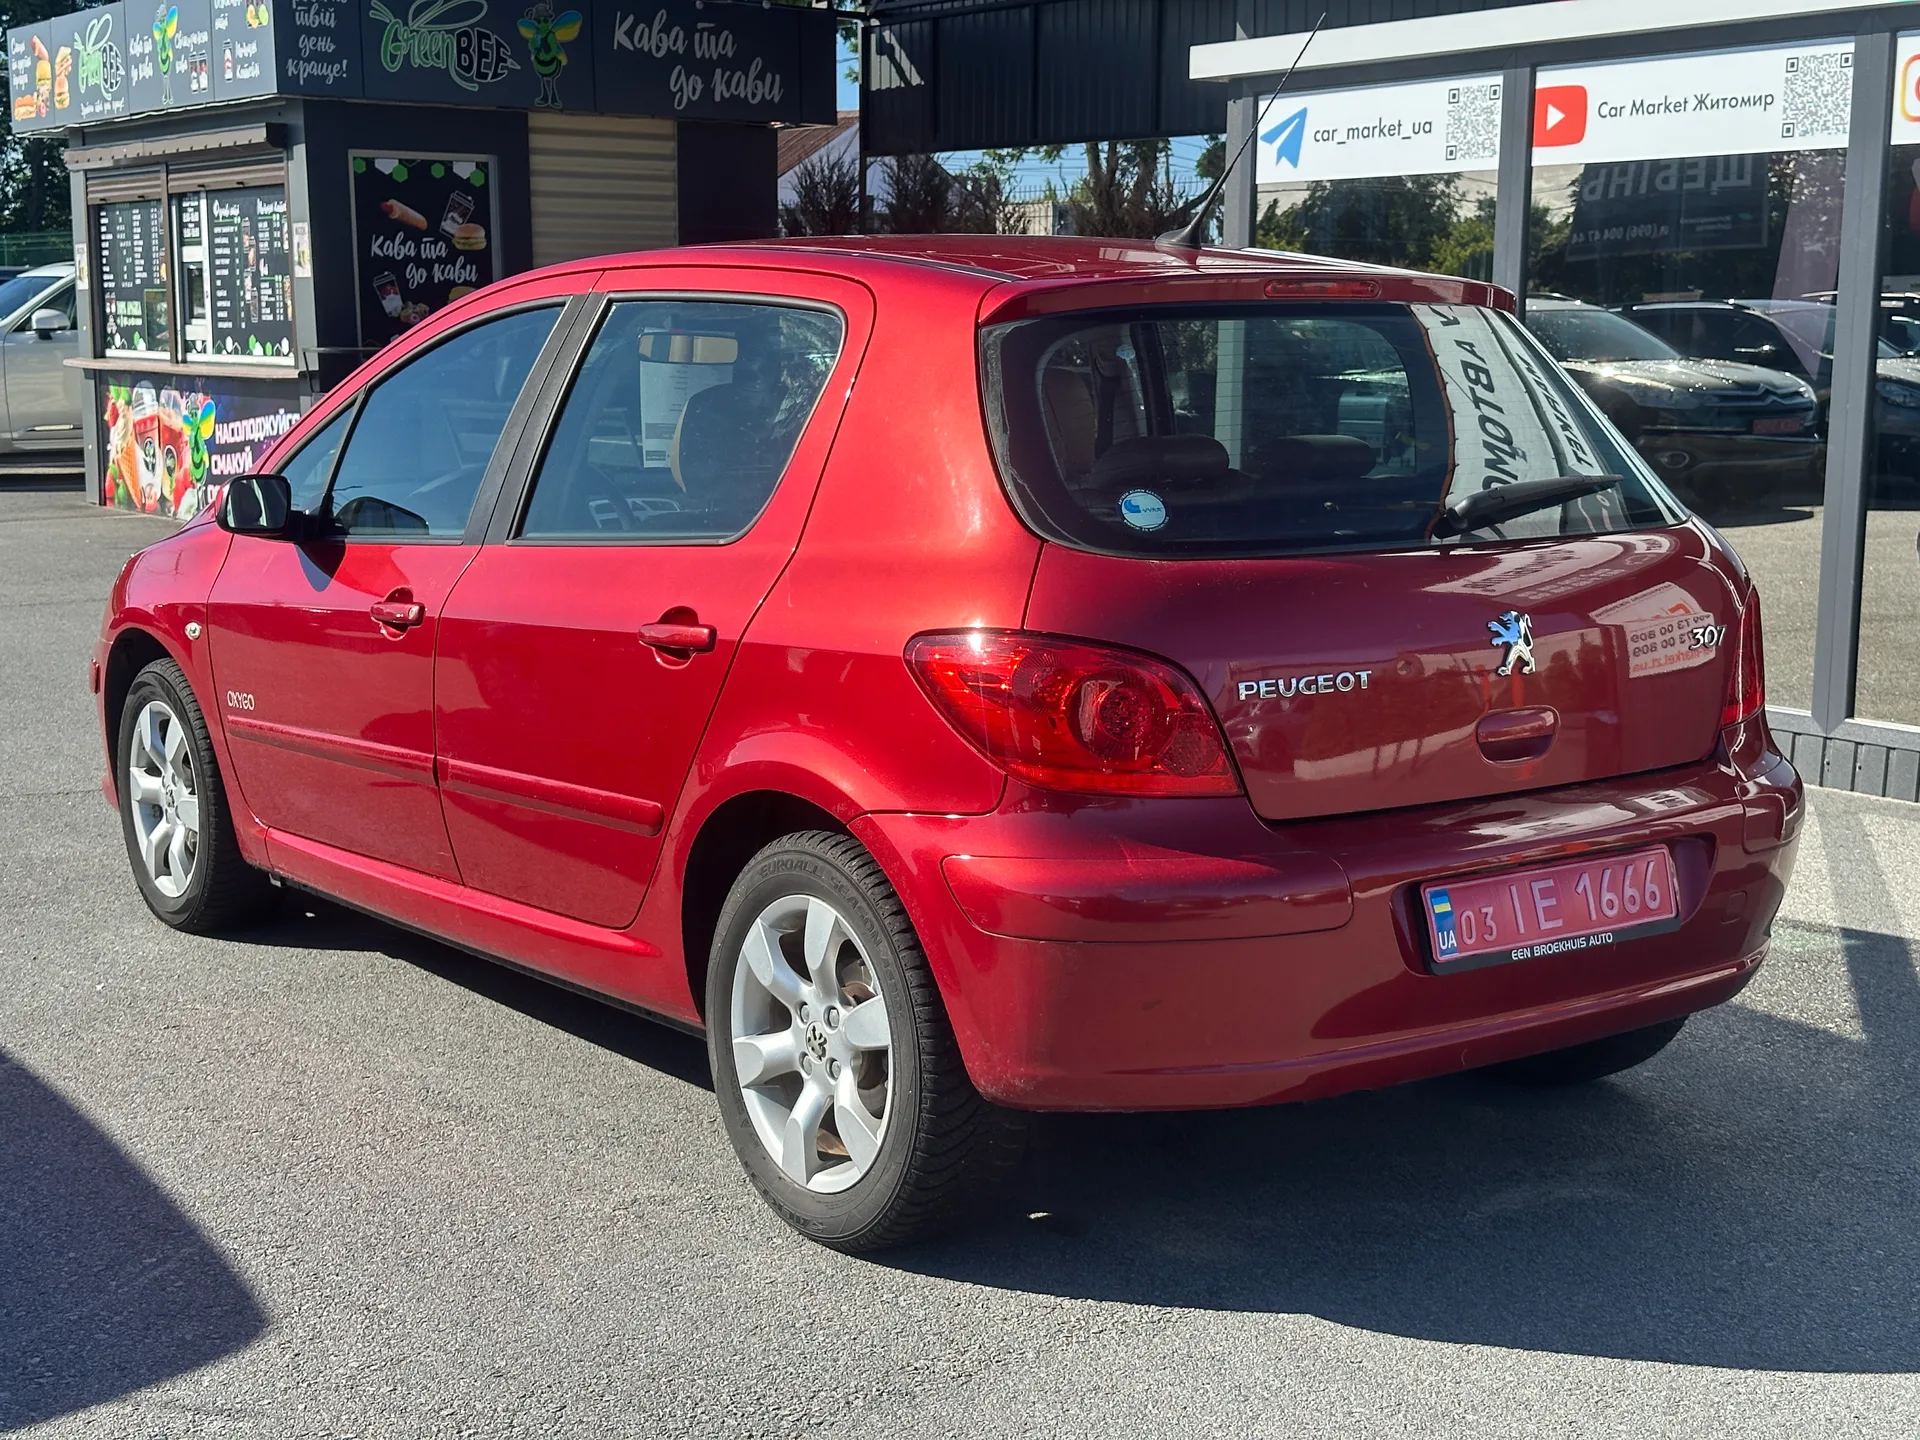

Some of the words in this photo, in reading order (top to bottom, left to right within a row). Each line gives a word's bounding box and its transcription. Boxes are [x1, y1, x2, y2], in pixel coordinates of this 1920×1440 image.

[295, 3, 337, 28] твій
[298, 34, 336, 57] день
[613, 9, 688, 58] Кава
[694, 22, 737, 60] та
[287, 59, 348, 85] краще!
[669, 64, 704, 110] до
[711, 57, 784, 104] кави
[1597, 100, 1624, 119] Car
[1629, 95, 1689, 118] Market
[1692, 92, 1775, 113] Житомир
[1313, 117, 1433, 145] car_market_ua
[371, 231, 417, 260] Кава
[420, 237, 449, 259] та
[405, 262, 427, 289] до
[432, 255, 479, 283] кави
[211, 445, 253, 475] СМАКУЙ
[1238, 671, 1372, 700] PEUGEOT
[227, 690, 255, 711] OXYGO
[1460, 905, 1497, 945] 03
[1574, 860, 1661, 921] 1666
[1438, 930, 1458, 950] UA
[1511, 947, 1531, 960] EEN
[1533, 937, 1587, 957] BROEKHUIS
[1588, 932, 1613, 946] AUTO
